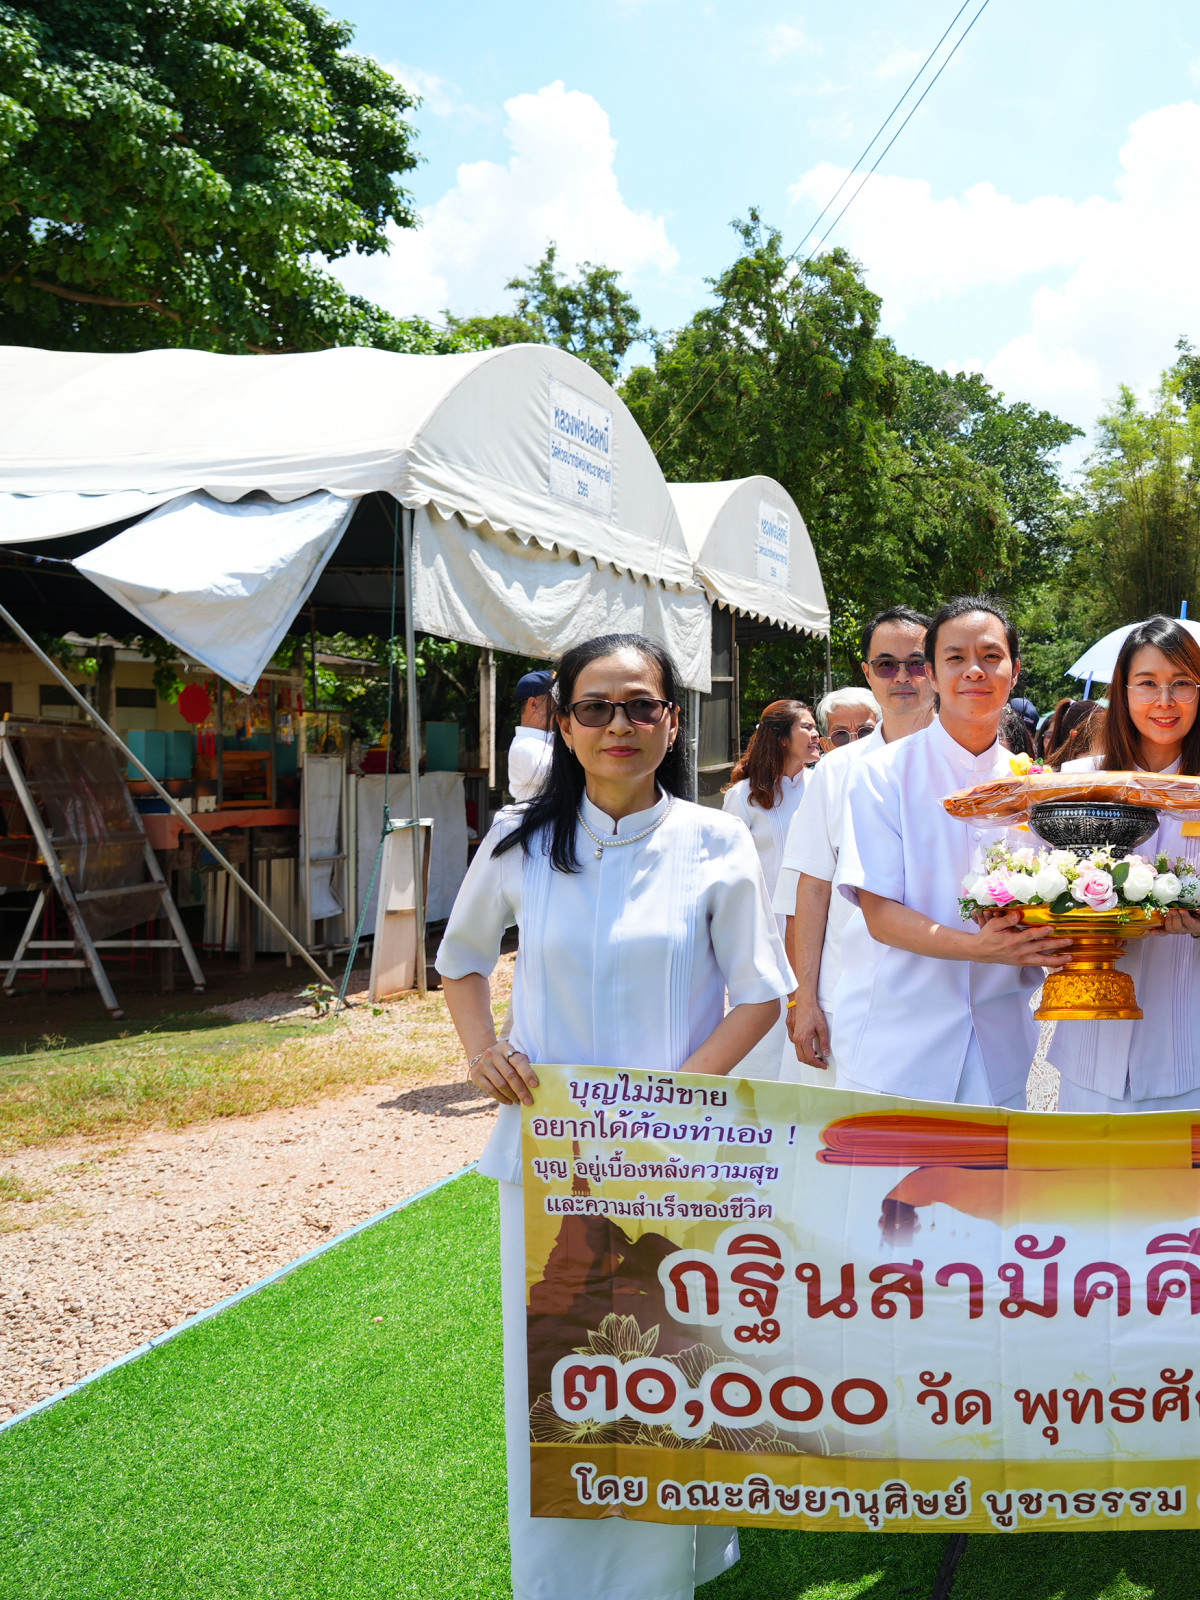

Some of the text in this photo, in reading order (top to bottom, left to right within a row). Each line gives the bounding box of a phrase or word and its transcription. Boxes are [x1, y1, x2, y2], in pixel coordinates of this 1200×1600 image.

[569, 1073, 728, 1109] บุญไม่มีขาย
[532, 1110, 773, 1145] อยากได้ต้องทำเอง
[534, 1151, 779, 1184] บุญ อยู่เบื้องหลังความสุข
[546, 1195, 773, 1220] และความสำเร็จของชีวิต
[563, 1363, 889, 1428] ๓๐,๐๐๐
[916, 1370, 993, 1426] วัด
[575, 1467, 644, 1505] โดย
[660, 1478, 968, 1527] คณะศิษยานุศิษย์
[986, 1486, 1183, 1528] บูชาธรรม
